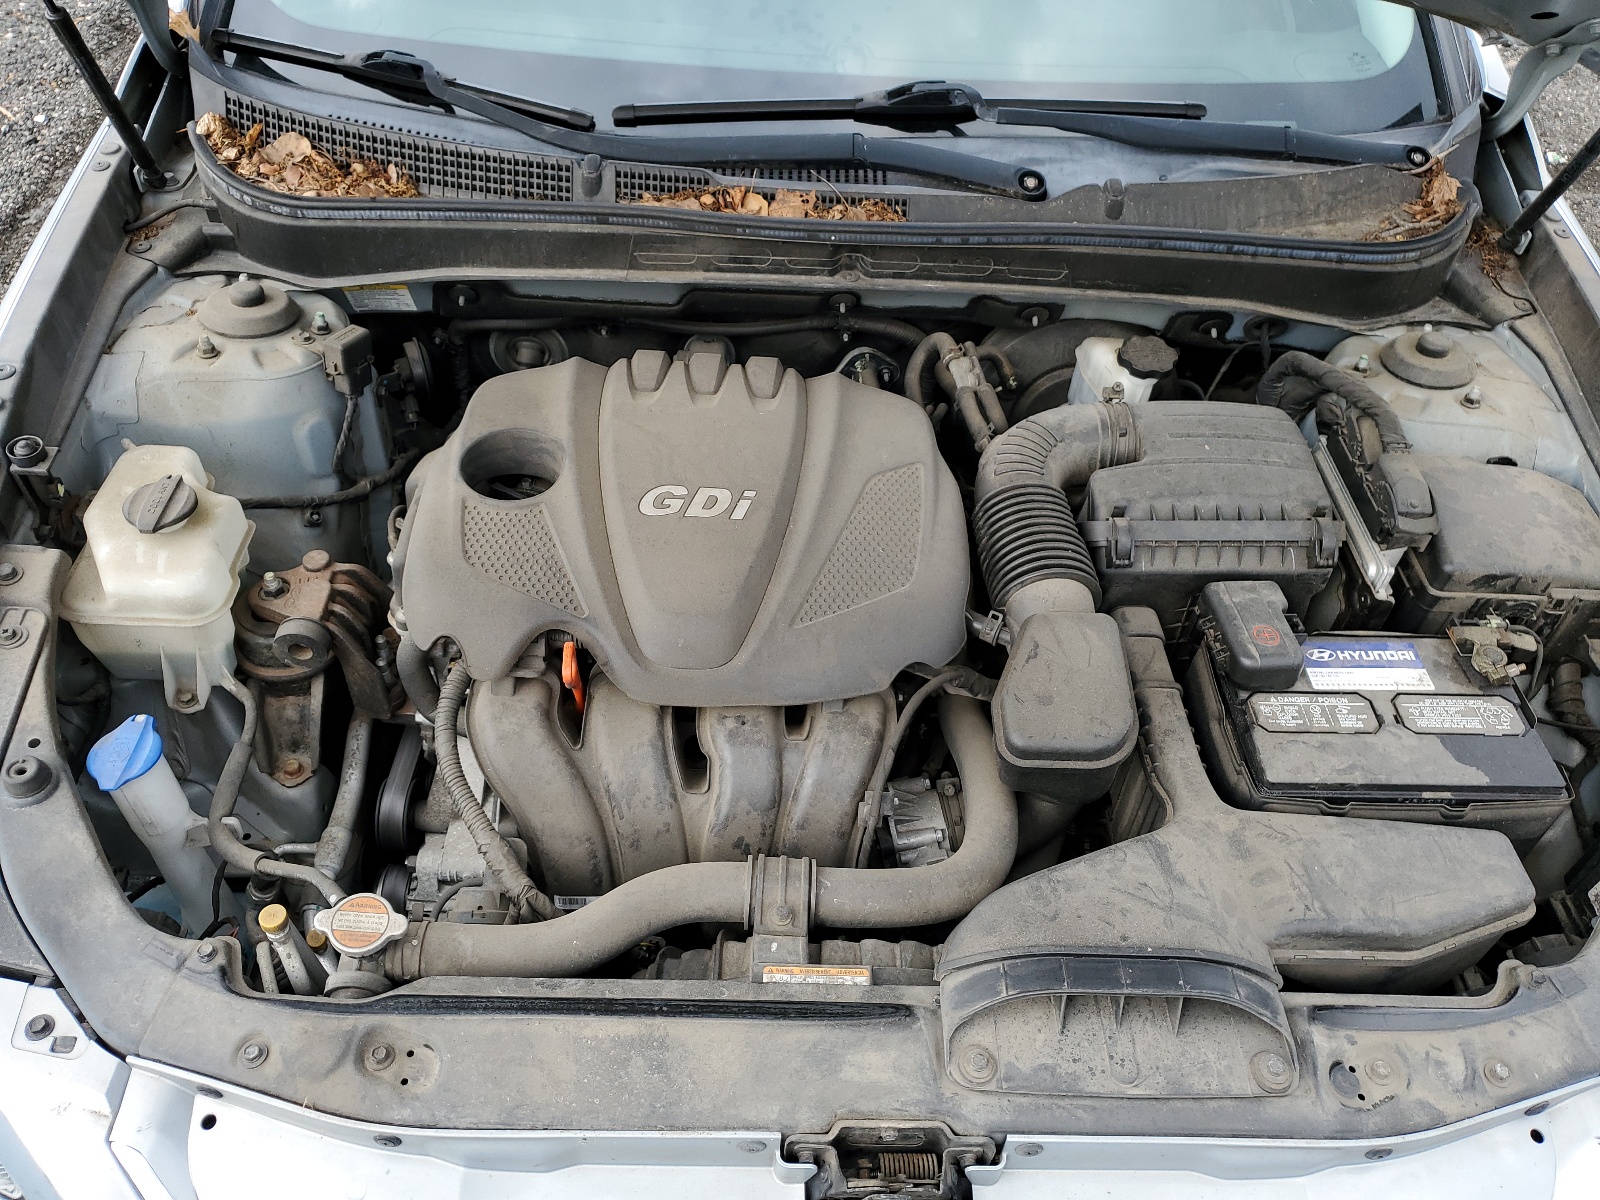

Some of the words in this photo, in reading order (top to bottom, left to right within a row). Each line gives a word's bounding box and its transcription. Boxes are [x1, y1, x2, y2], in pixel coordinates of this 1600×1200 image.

[638, 485, 757, 520] GDi
[1336, 650, 1416, 661] HYUNDAI
[357, 902, 382, 910] WARNING
